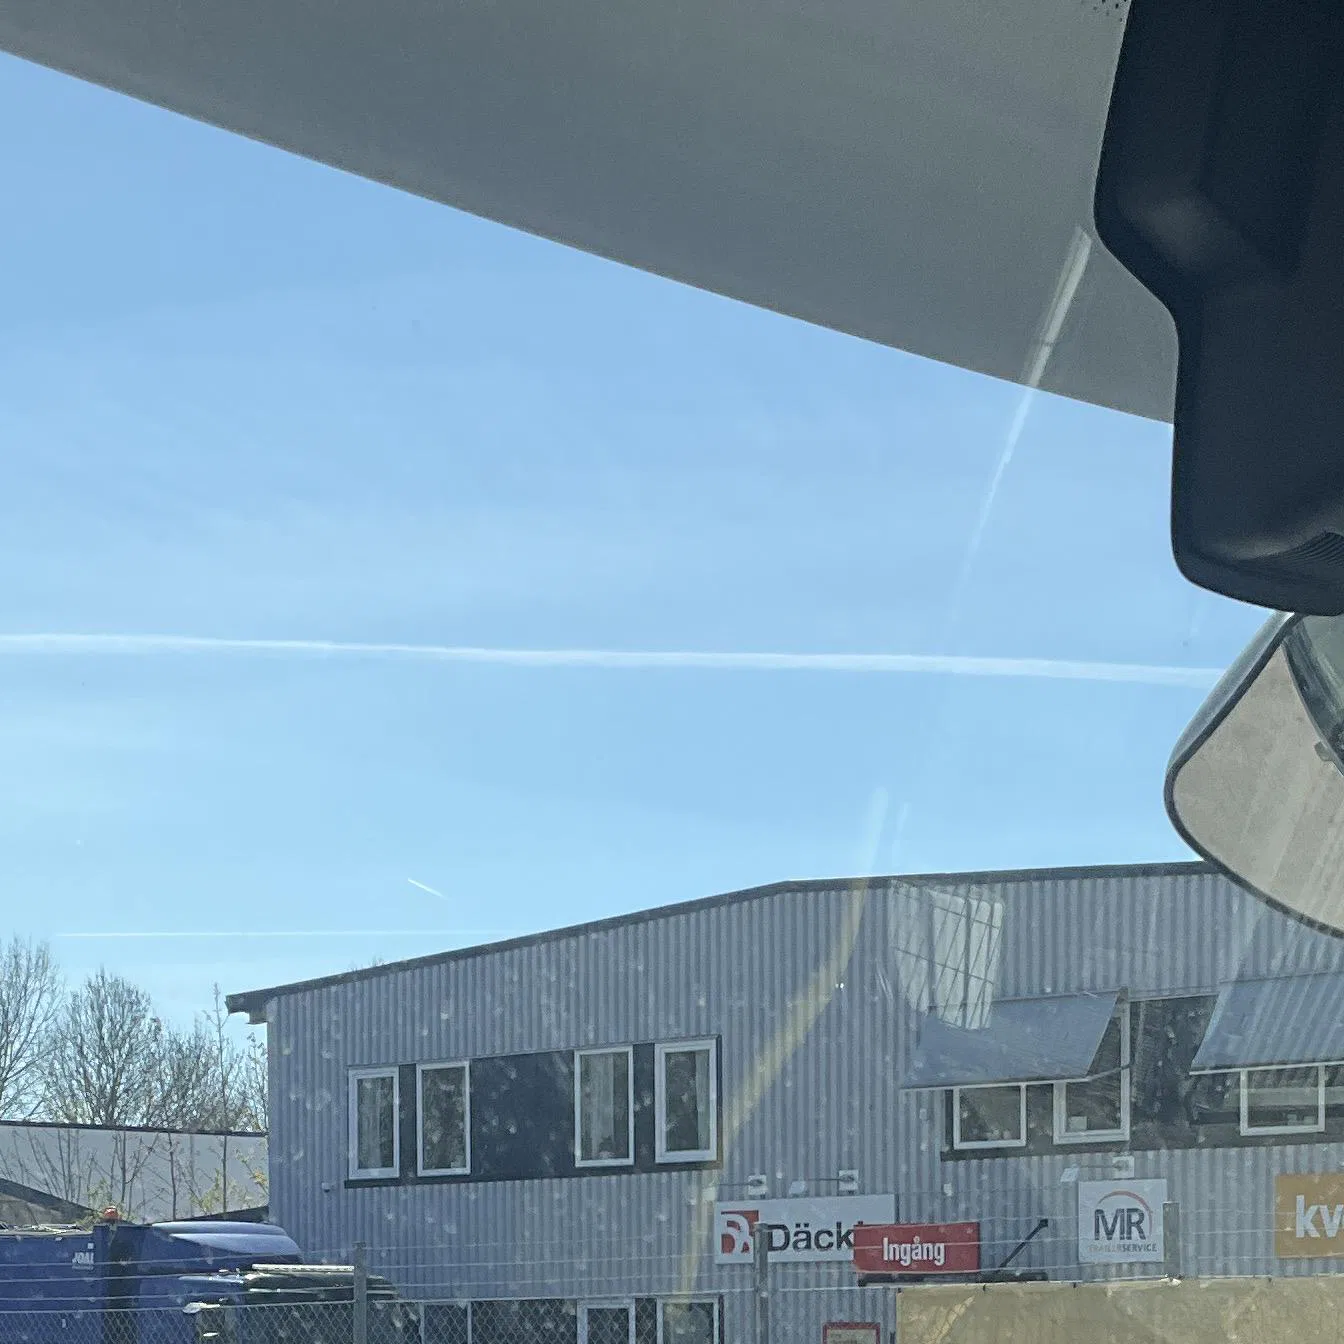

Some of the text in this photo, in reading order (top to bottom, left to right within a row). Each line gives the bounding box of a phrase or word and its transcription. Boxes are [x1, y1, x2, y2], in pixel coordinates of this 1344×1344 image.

[766, 1219, 864, 1253] Däck
[1093, 1207, 1147, 1241] MR
[882, 1235, 946, 1267] Ingång
